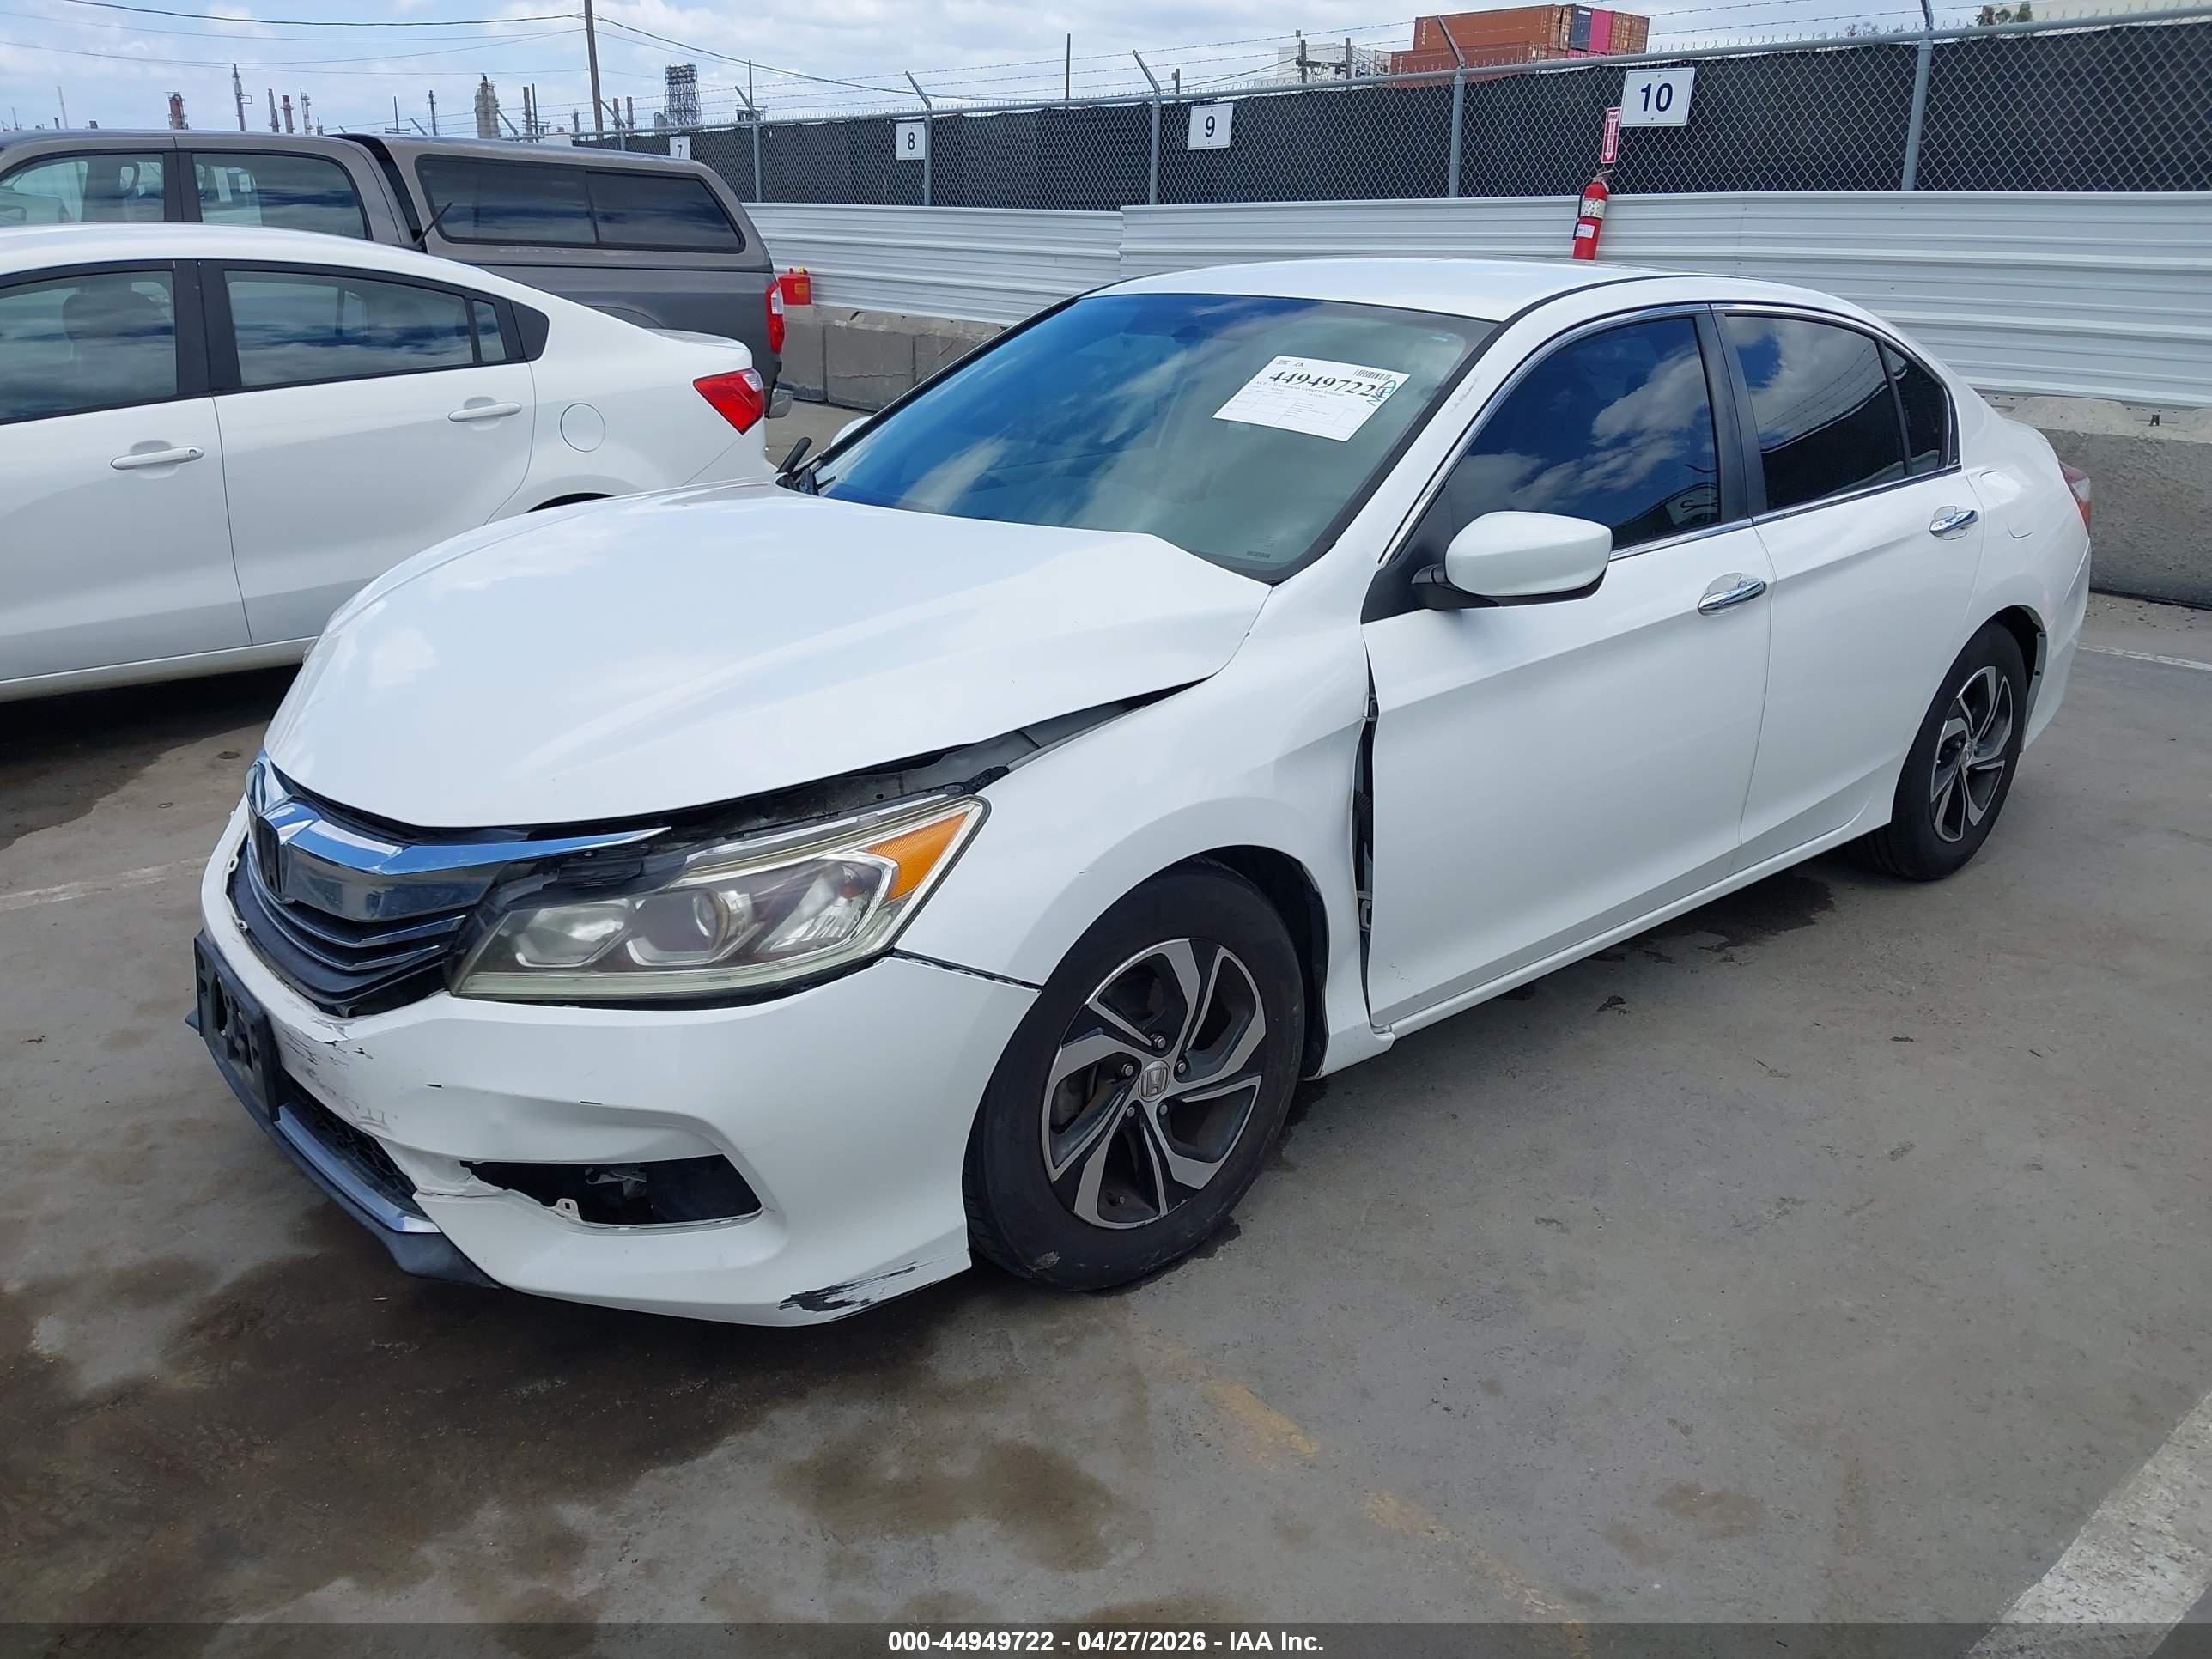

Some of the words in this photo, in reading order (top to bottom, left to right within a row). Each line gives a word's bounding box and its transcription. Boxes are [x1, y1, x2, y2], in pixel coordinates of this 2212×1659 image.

[1640, 82, 1673, 112] 10
[1205, 115, 1215, 138] 9
[677, 144, 683, 159] 7
[908, 131, 915, 150] 8
[1269, 370, 1376, 397] 44949722
